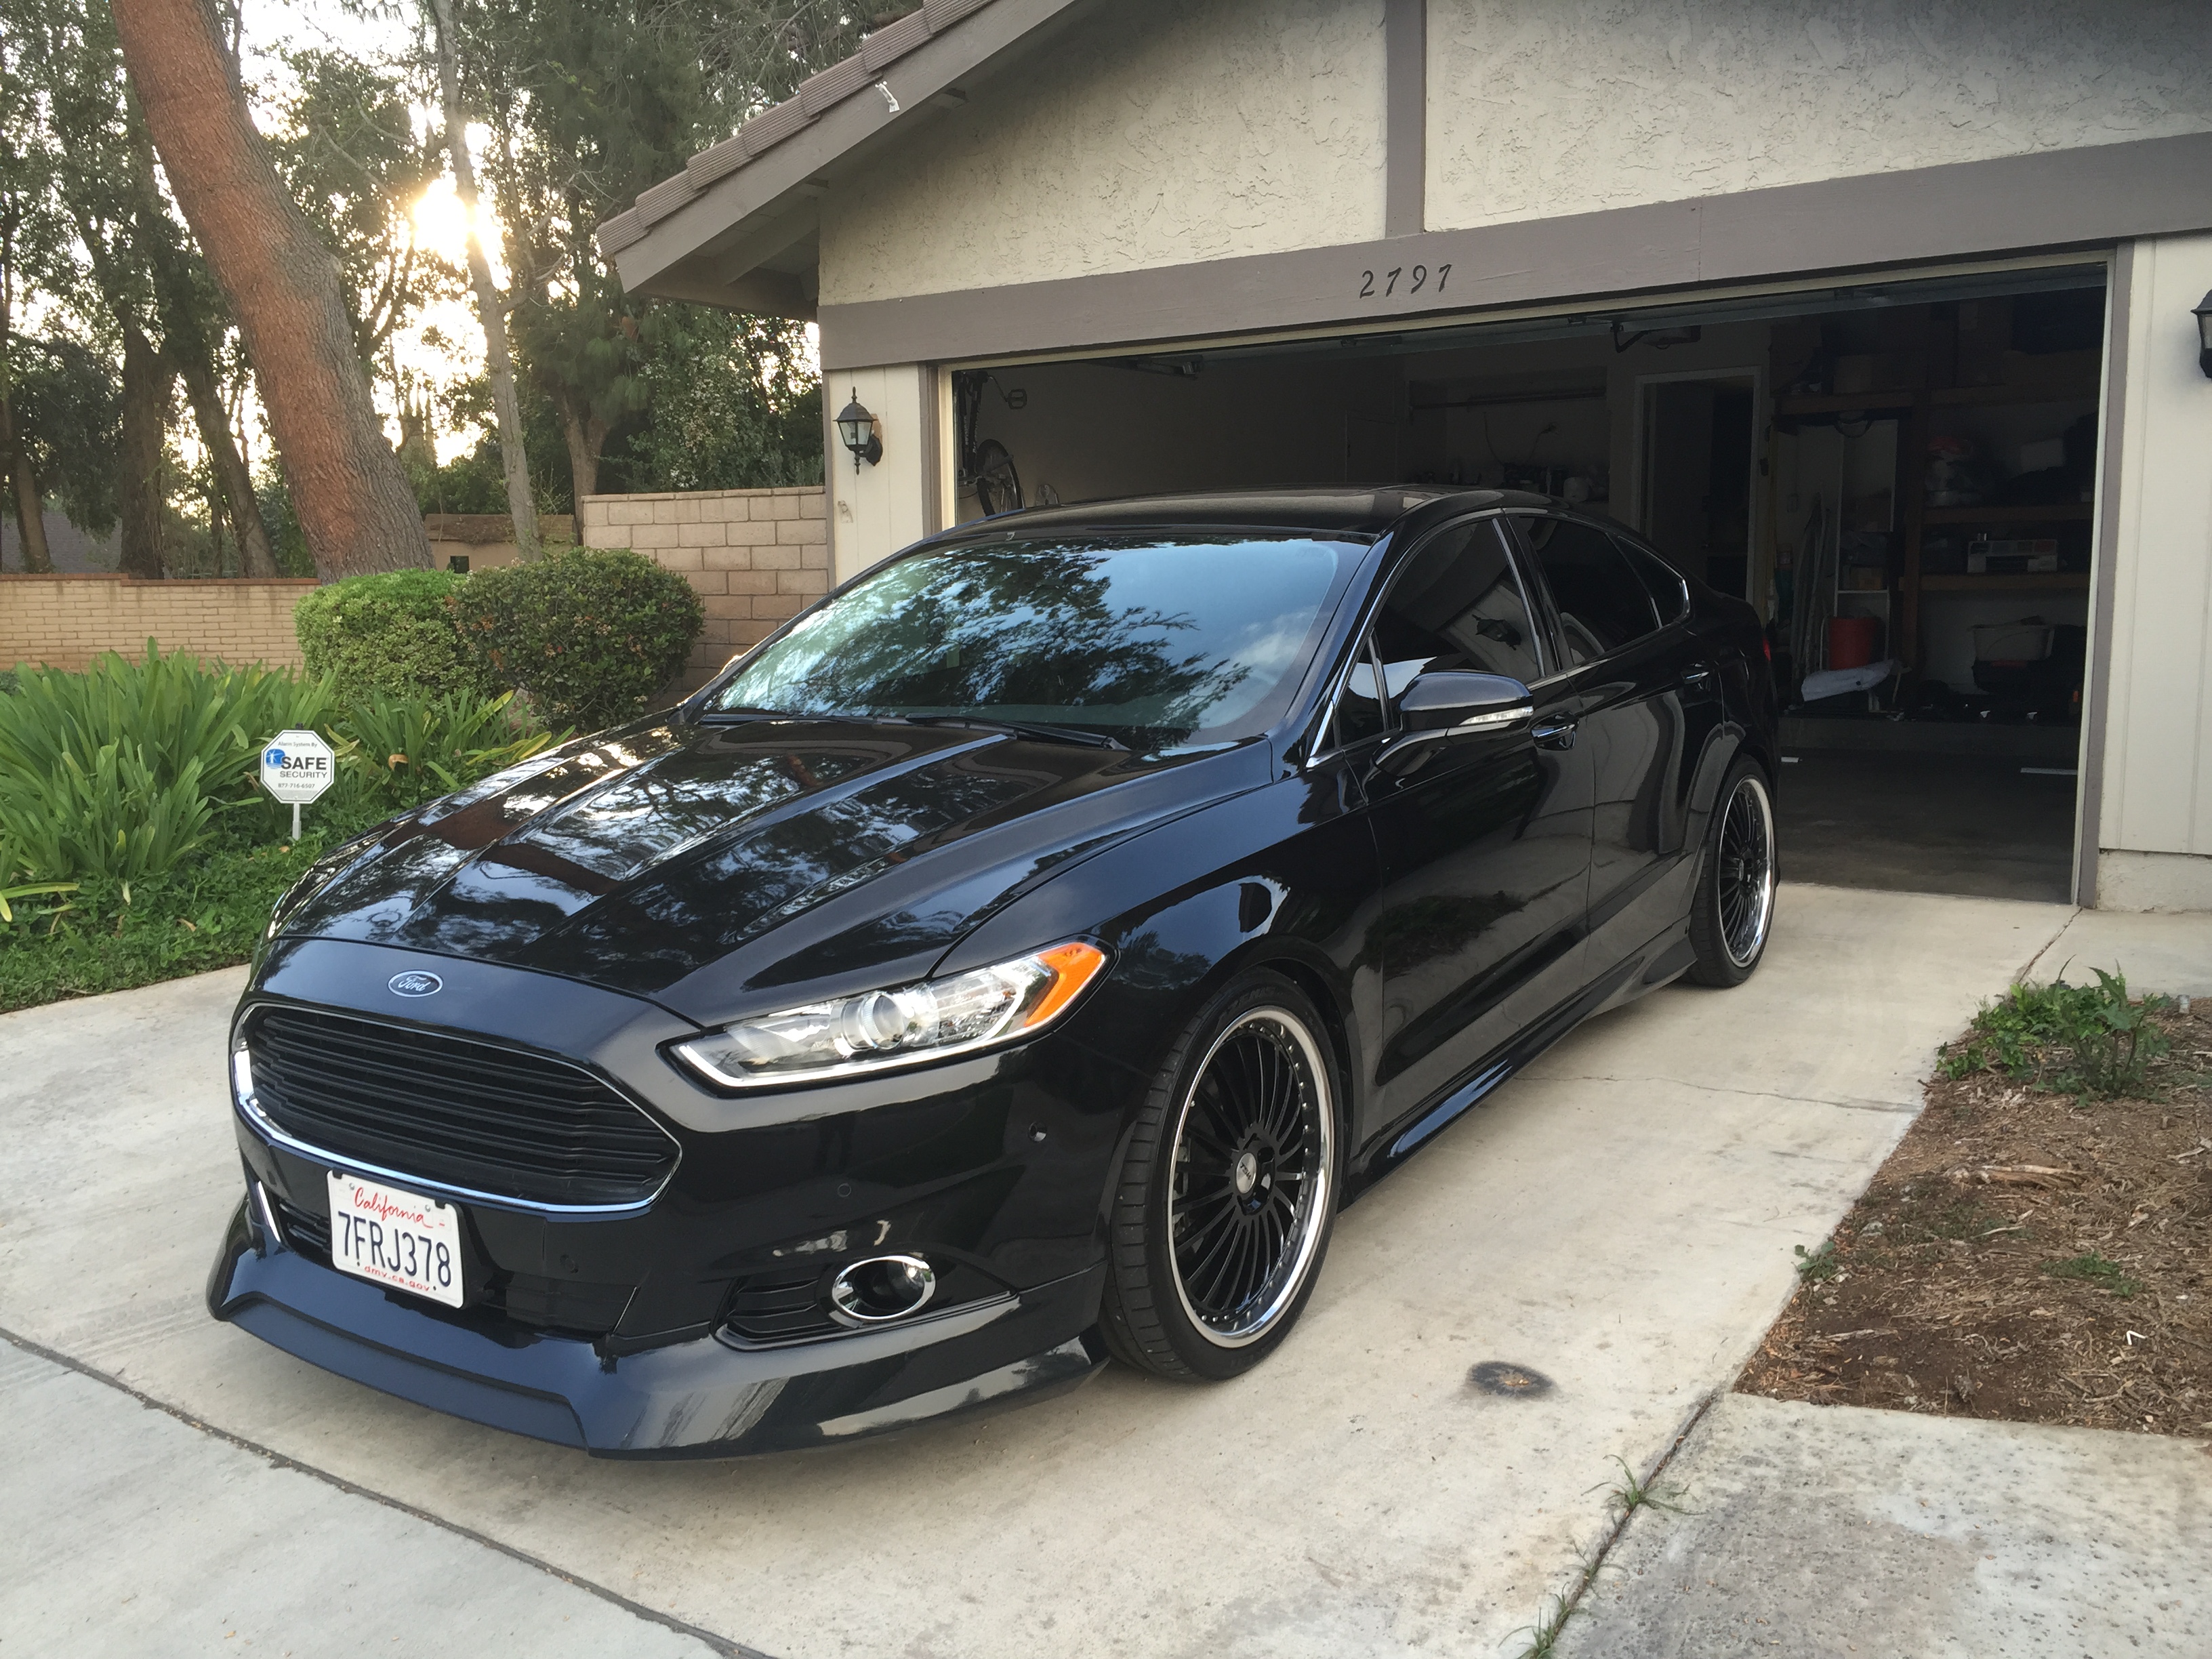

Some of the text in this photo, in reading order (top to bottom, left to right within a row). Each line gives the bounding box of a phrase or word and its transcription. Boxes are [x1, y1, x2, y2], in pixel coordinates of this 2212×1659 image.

[1359, 264, 1452, 299] 2797
[280, 771, 327, 779] SECURITY
[281, 756, 327, 770] SAFE
[398, 975, 432, 992] Ford
[354, 1187, 434, 1229] California
[338, 1211, 451, 1288] 7FRJ378
[364, 1265, 430, 1292] dmv.ca.gov
